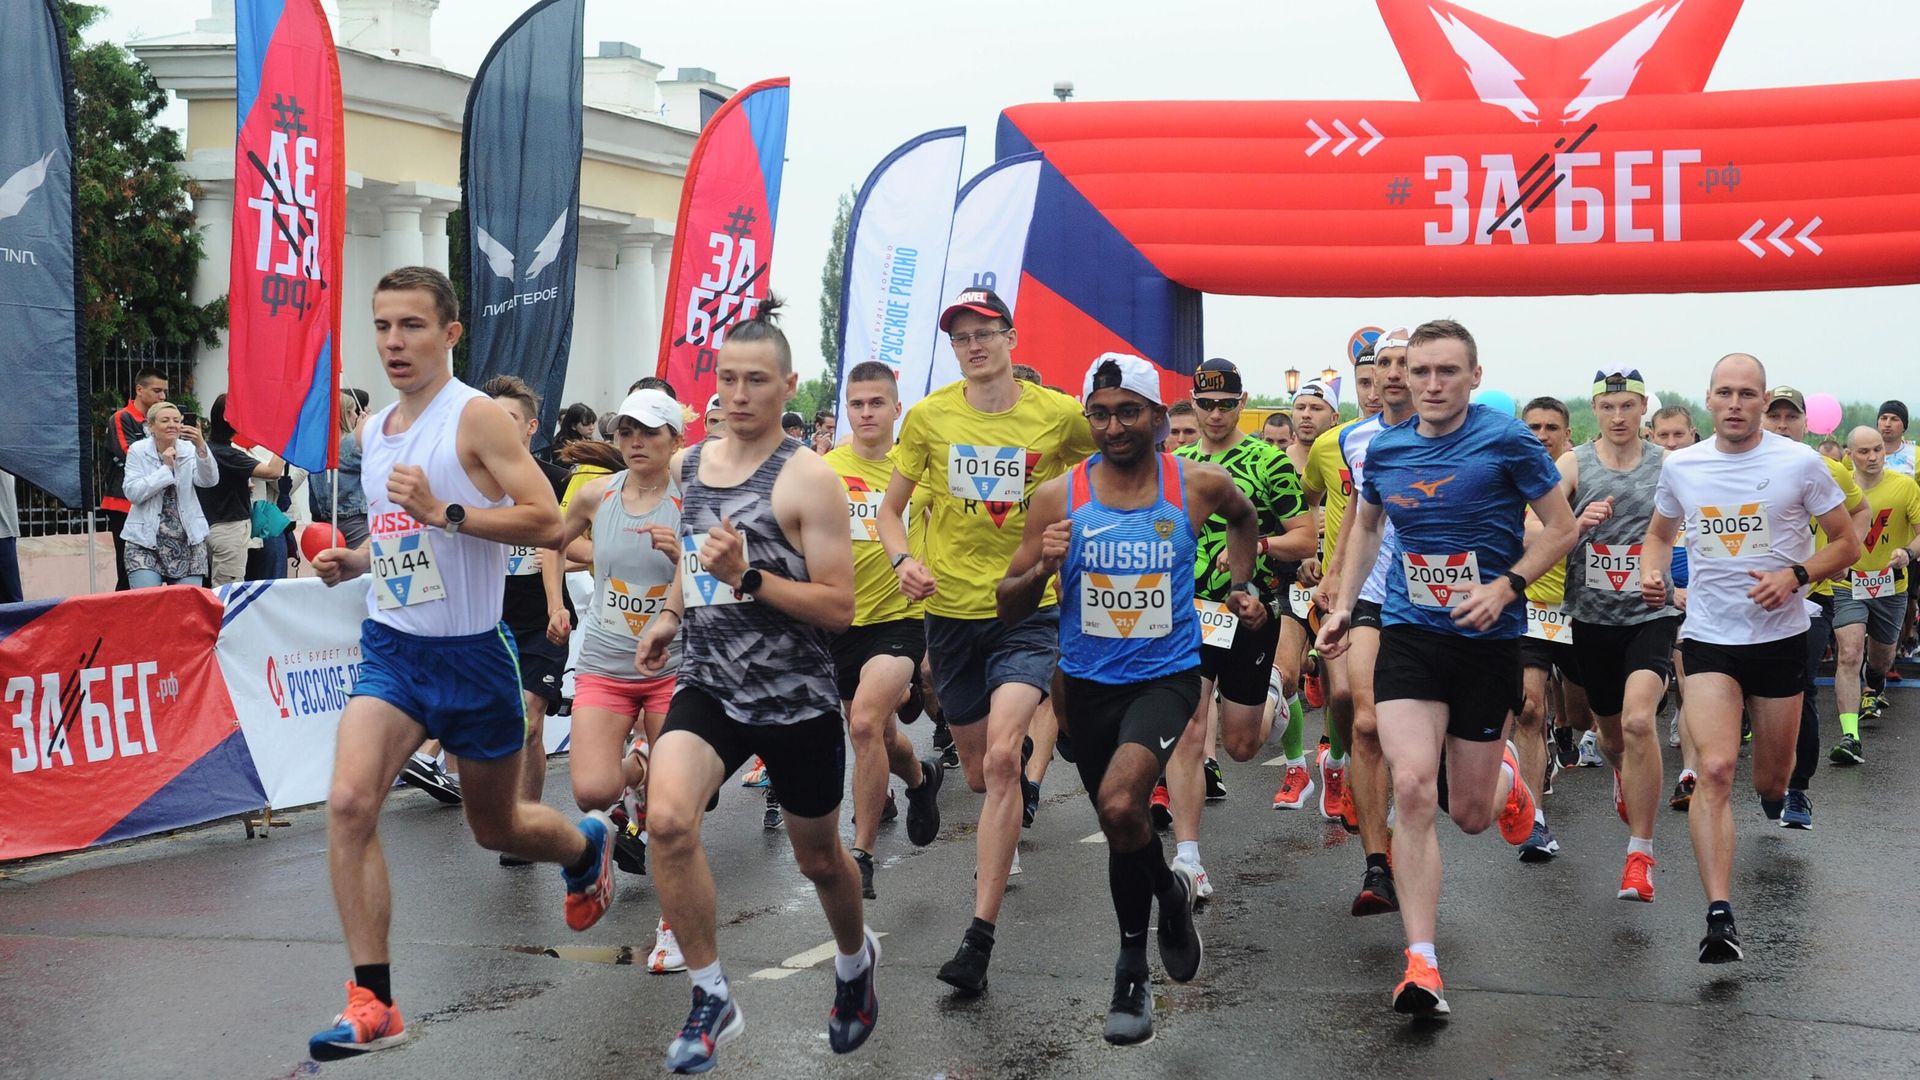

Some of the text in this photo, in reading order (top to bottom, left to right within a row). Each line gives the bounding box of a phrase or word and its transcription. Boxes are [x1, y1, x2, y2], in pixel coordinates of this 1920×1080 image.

[879, 247, 919, 364] РУССКОЕ РАДИО
[954, 458, 1020, 478] 10166
[981, 482, 989, 491] 5
[1700, 516, 1763, 535] 30062
[1081, 540, 1177, 569] RUSSIA
[1590, 555, 1641, 571] 2015
[373, 550, 431, 580] 10144
[1408, 565, 1474, 585] 20094
[1611, 575, 1624, 583] 10
[1855, 575, 1892, 587] 20008
[395, 582, 405, 595] 5
[703, 580, 712, 593] 5
[1434, 588, 1448, 599] 10
[1087, 588, 1165, 610] 30030
[309, 648, 341, 663] БУДЕТ
[286, 665, 347, 717] РУССКОЕ
